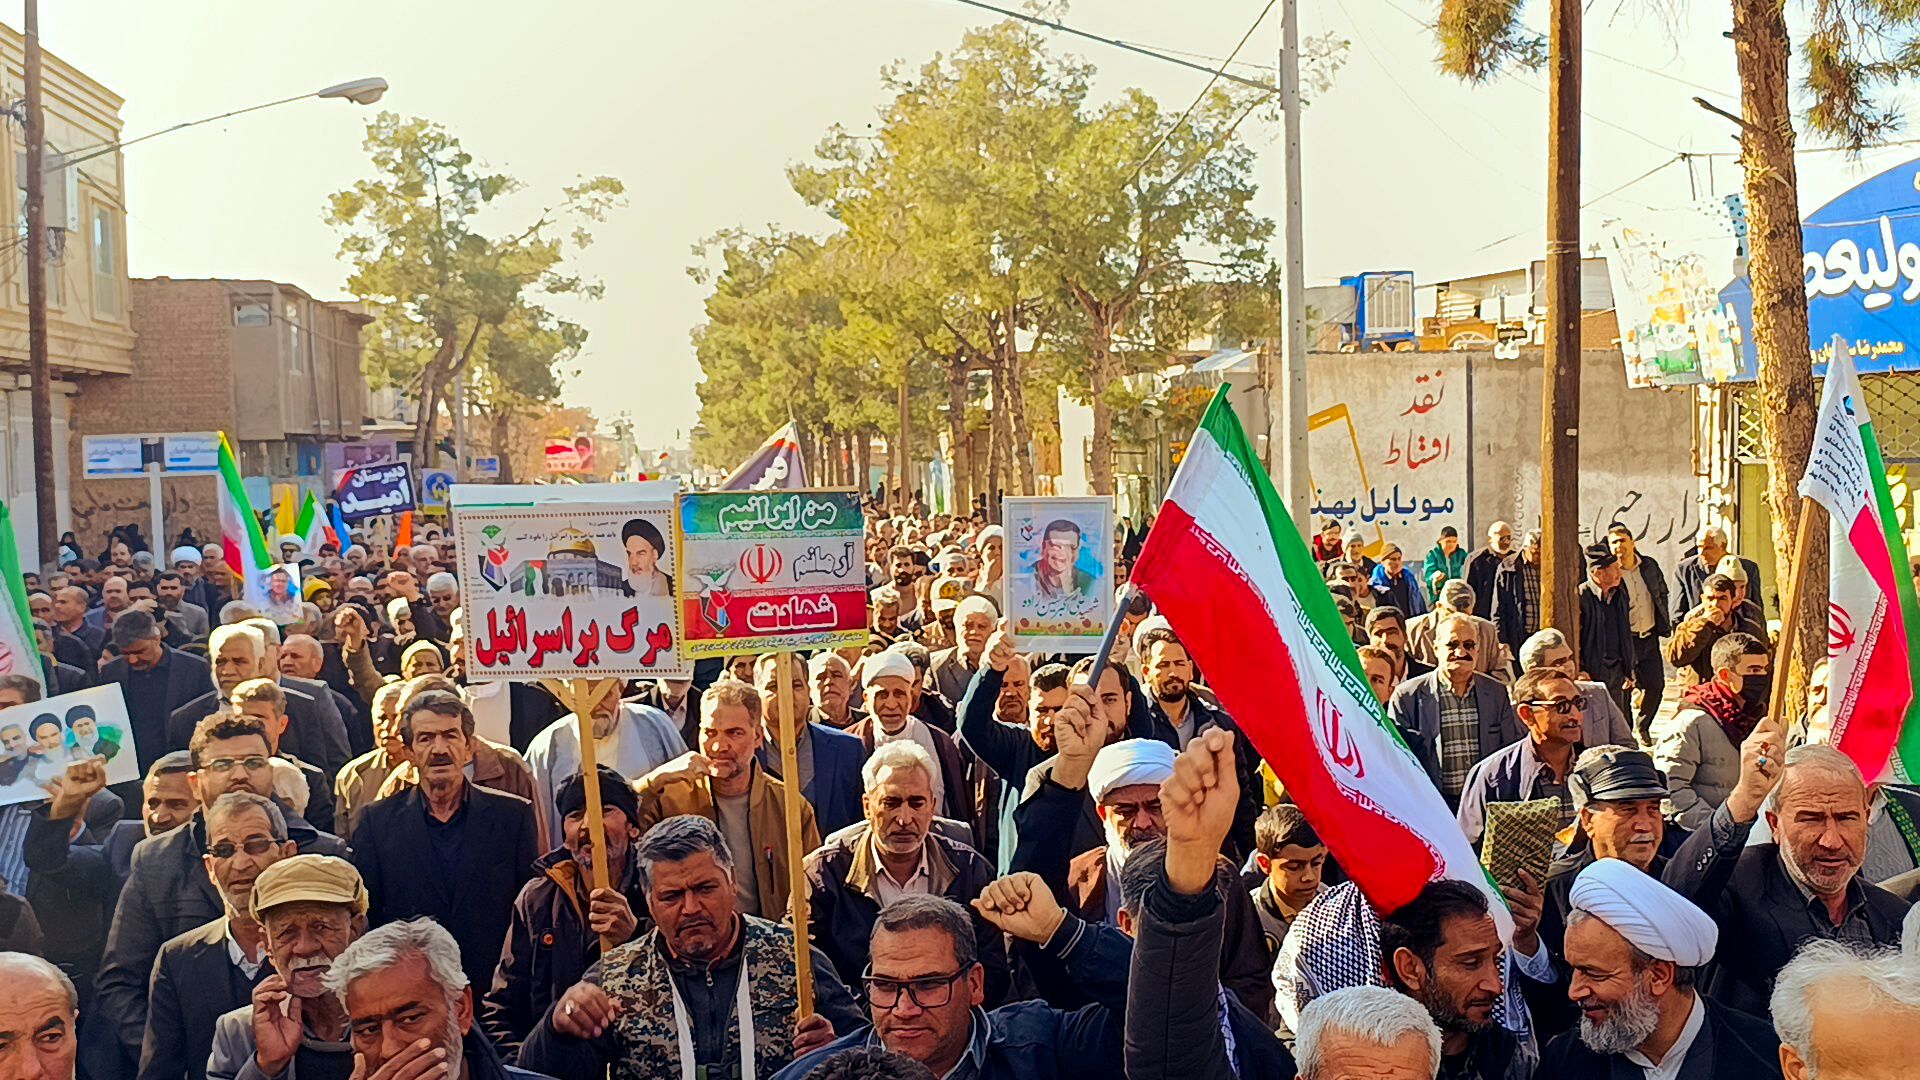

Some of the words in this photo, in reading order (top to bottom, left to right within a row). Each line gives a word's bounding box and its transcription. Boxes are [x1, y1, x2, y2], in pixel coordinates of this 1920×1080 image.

[1400, 369, 1446, 417] نقد
[341, 478, 411, 514] امید
[351, 465, 406, 488] دبیرستان
[718, 494, 801, 534] ایرانیم
[801, 499, 838, 530] من
[1360, 483, 1455, 526] موبایل
[793, 541, 855, 583] آرمانم
[746, 593, 838, 632] شهادت
[475, 604, 573, 668] اسرائیل
[573, 618, 600, 667] بر
[605, 606, 674, 668] مرگ
